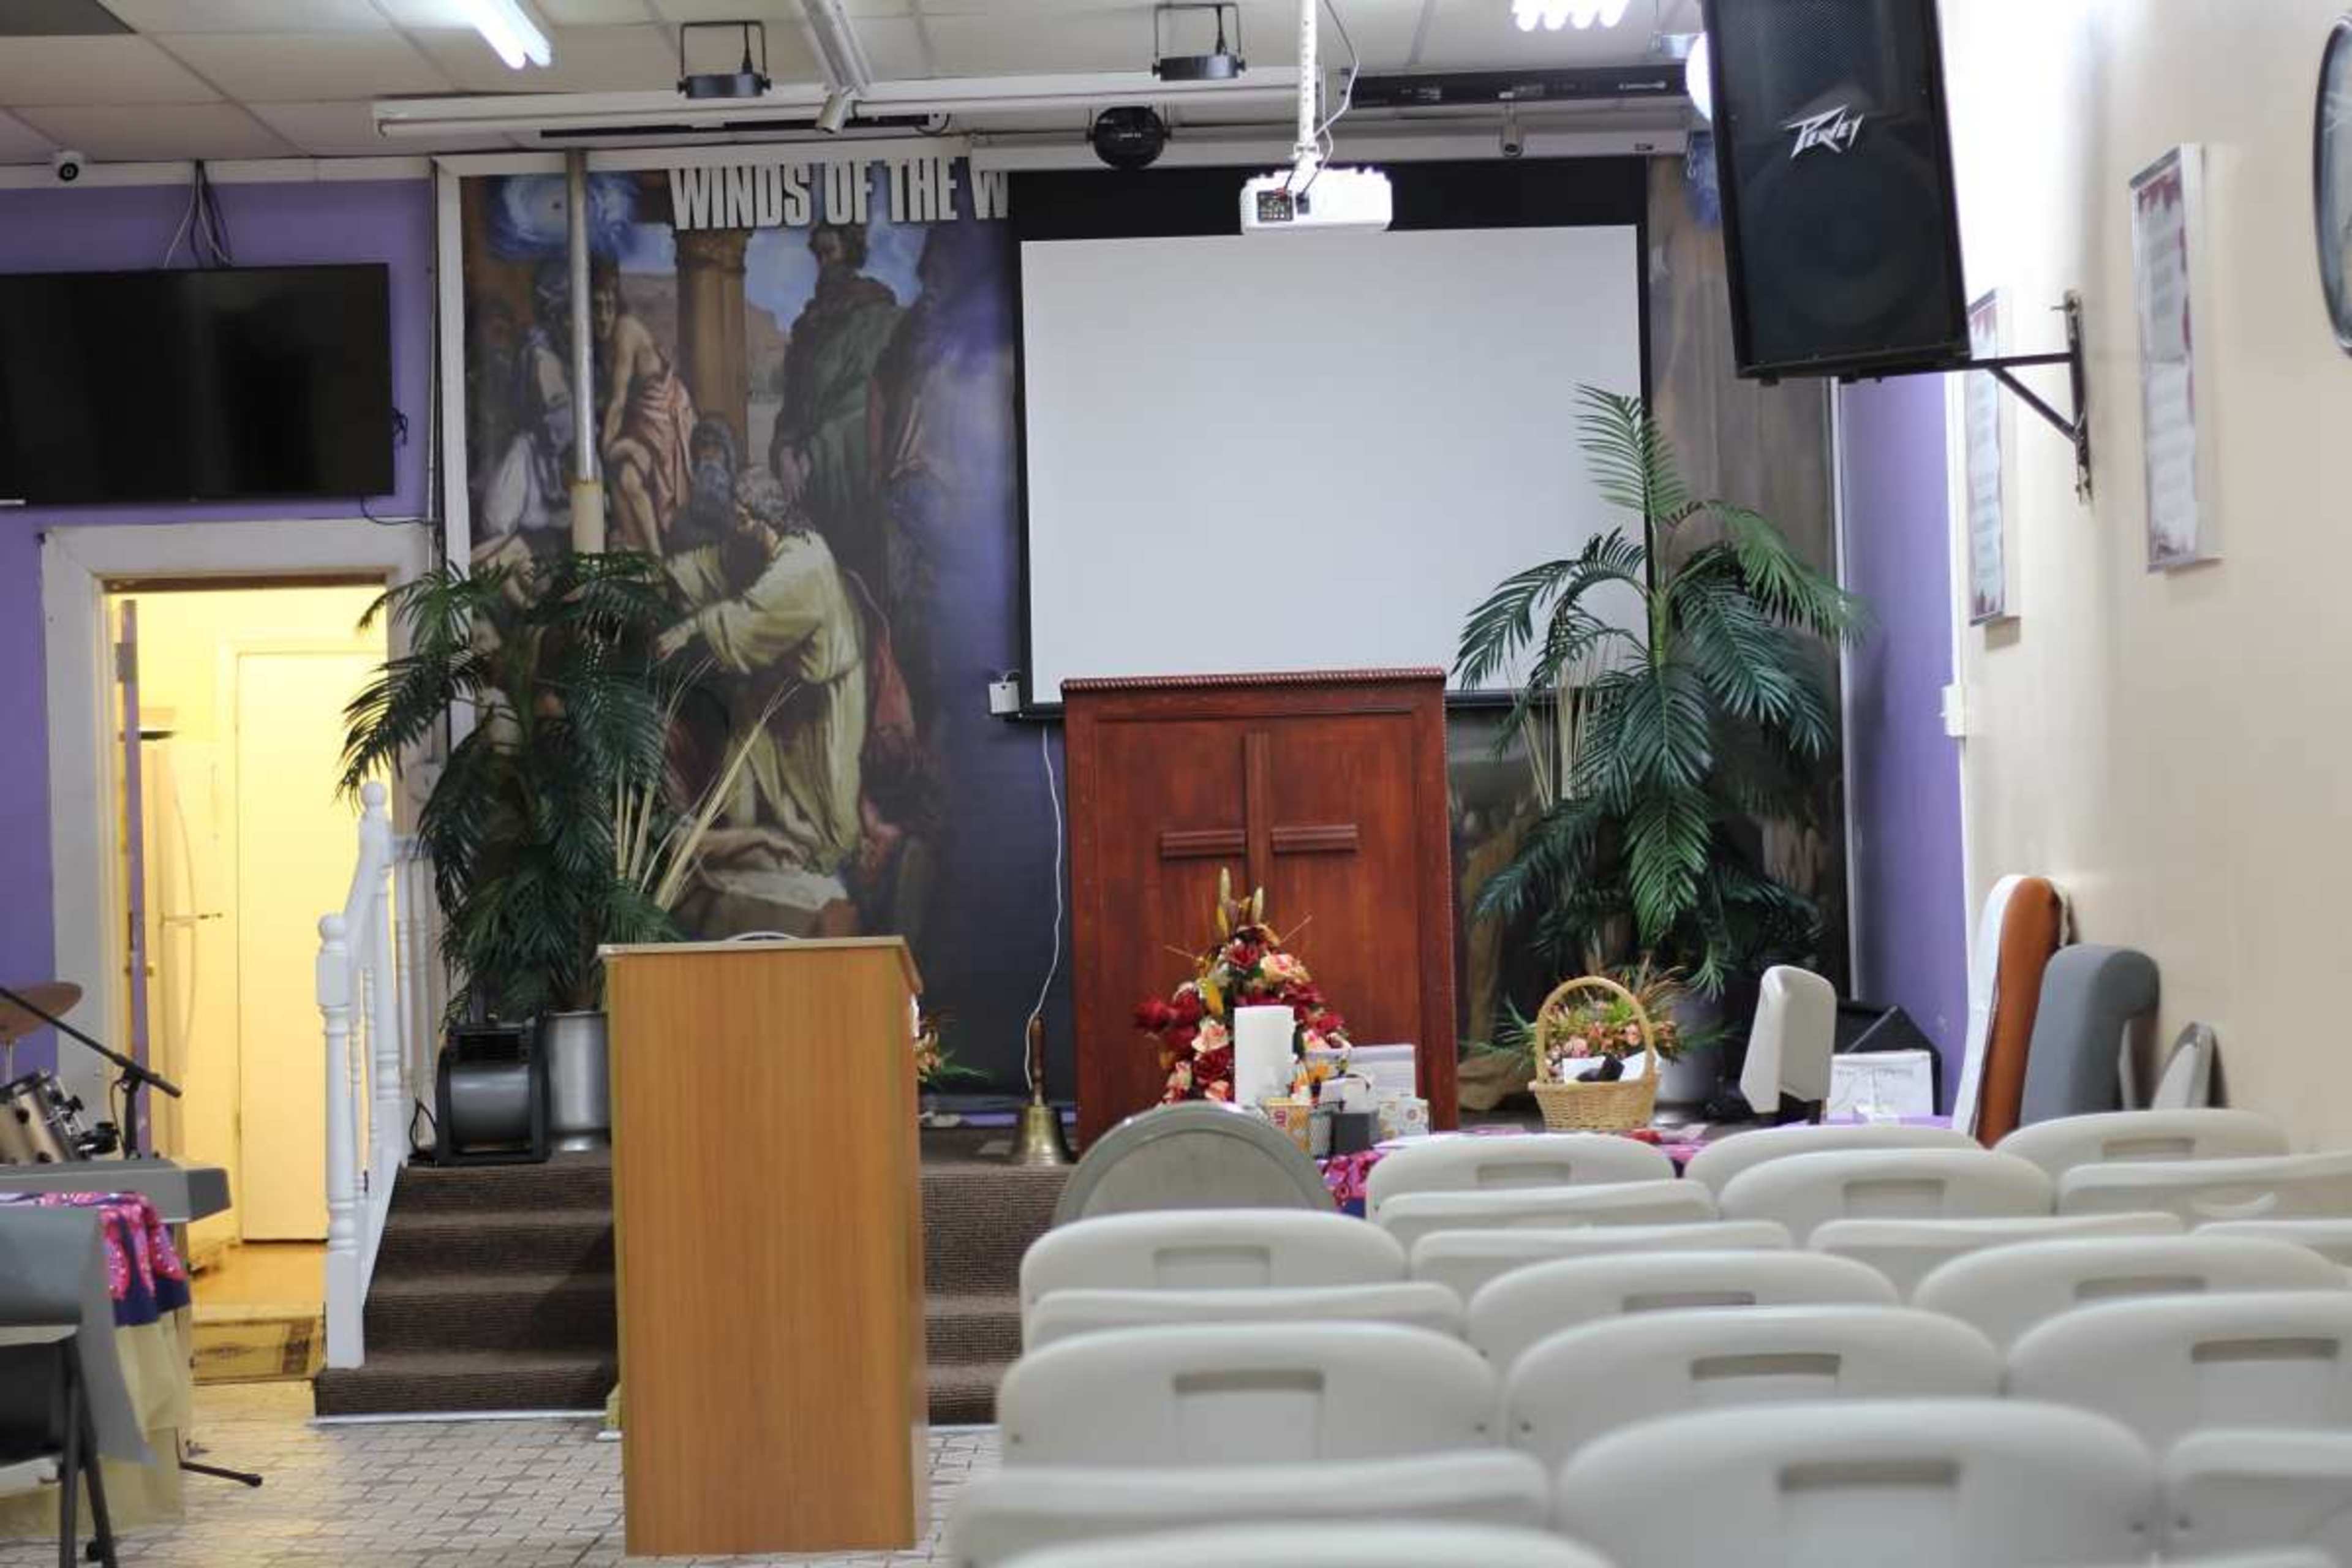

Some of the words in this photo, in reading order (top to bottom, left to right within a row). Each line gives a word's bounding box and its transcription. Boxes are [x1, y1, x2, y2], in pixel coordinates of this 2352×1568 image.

[669, 164, 811, 230] WINDS
[824, 158, 872, 225] OF
[886, 157, 958, 222] THE
